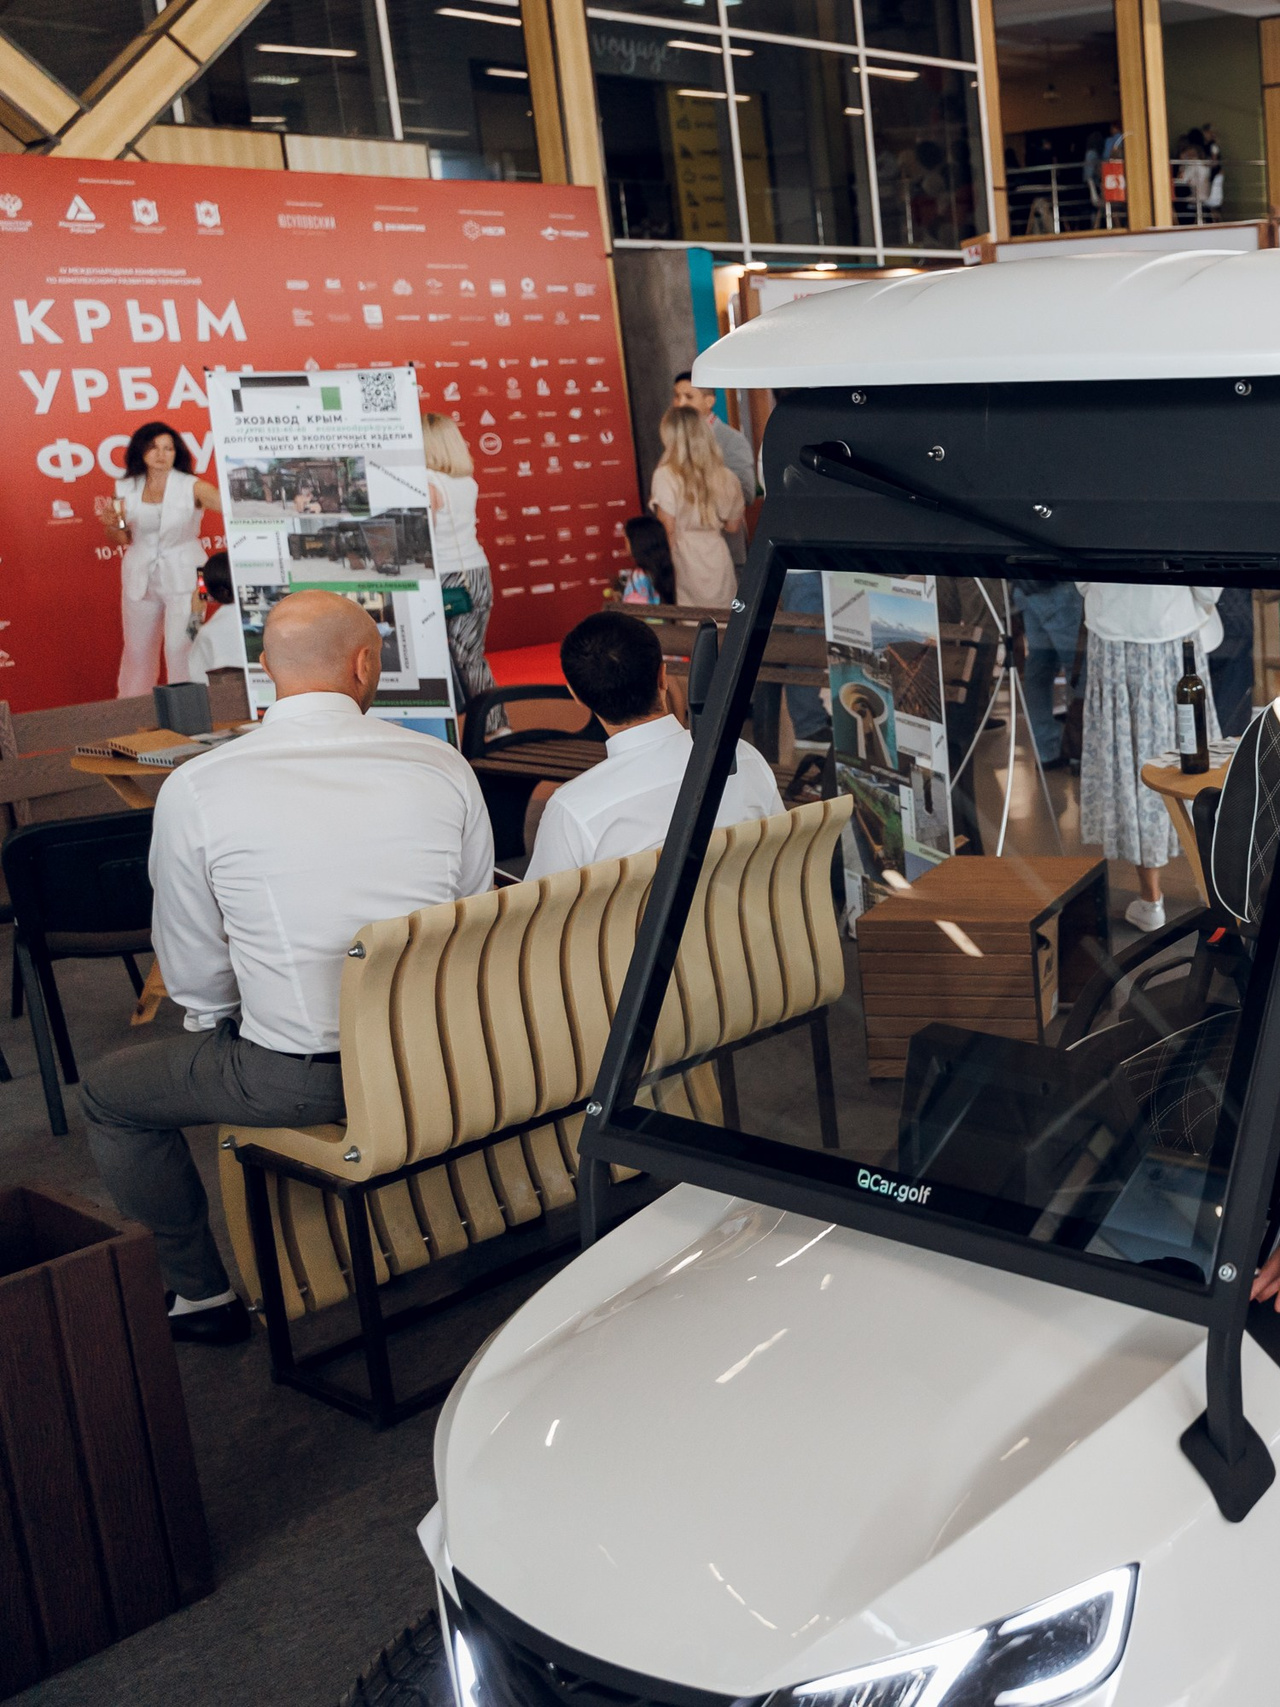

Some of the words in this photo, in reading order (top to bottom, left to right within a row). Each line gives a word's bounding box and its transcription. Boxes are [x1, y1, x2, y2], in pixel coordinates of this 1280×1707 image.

[13, 298, 248, 344] КРЫМ
[18, 363, 254, 415] УРБА
[234, 416, 300, 426] ЭКОЗАВОД
[307, 415, 344, 424] КРЫМ
[224, 435, 289, 444] ДОЛГОВЕЧНЫЕ
[301, 434, 367, 442] ЭКОЛОГИЧНЫЕ
[371, 432, 413, 441] ИЗДЕЛИЯ
[258, 443, 294, 451] ВАШЕГО
[297, 440, 383, 451] БЛАГОУСТРОЙСТВА
